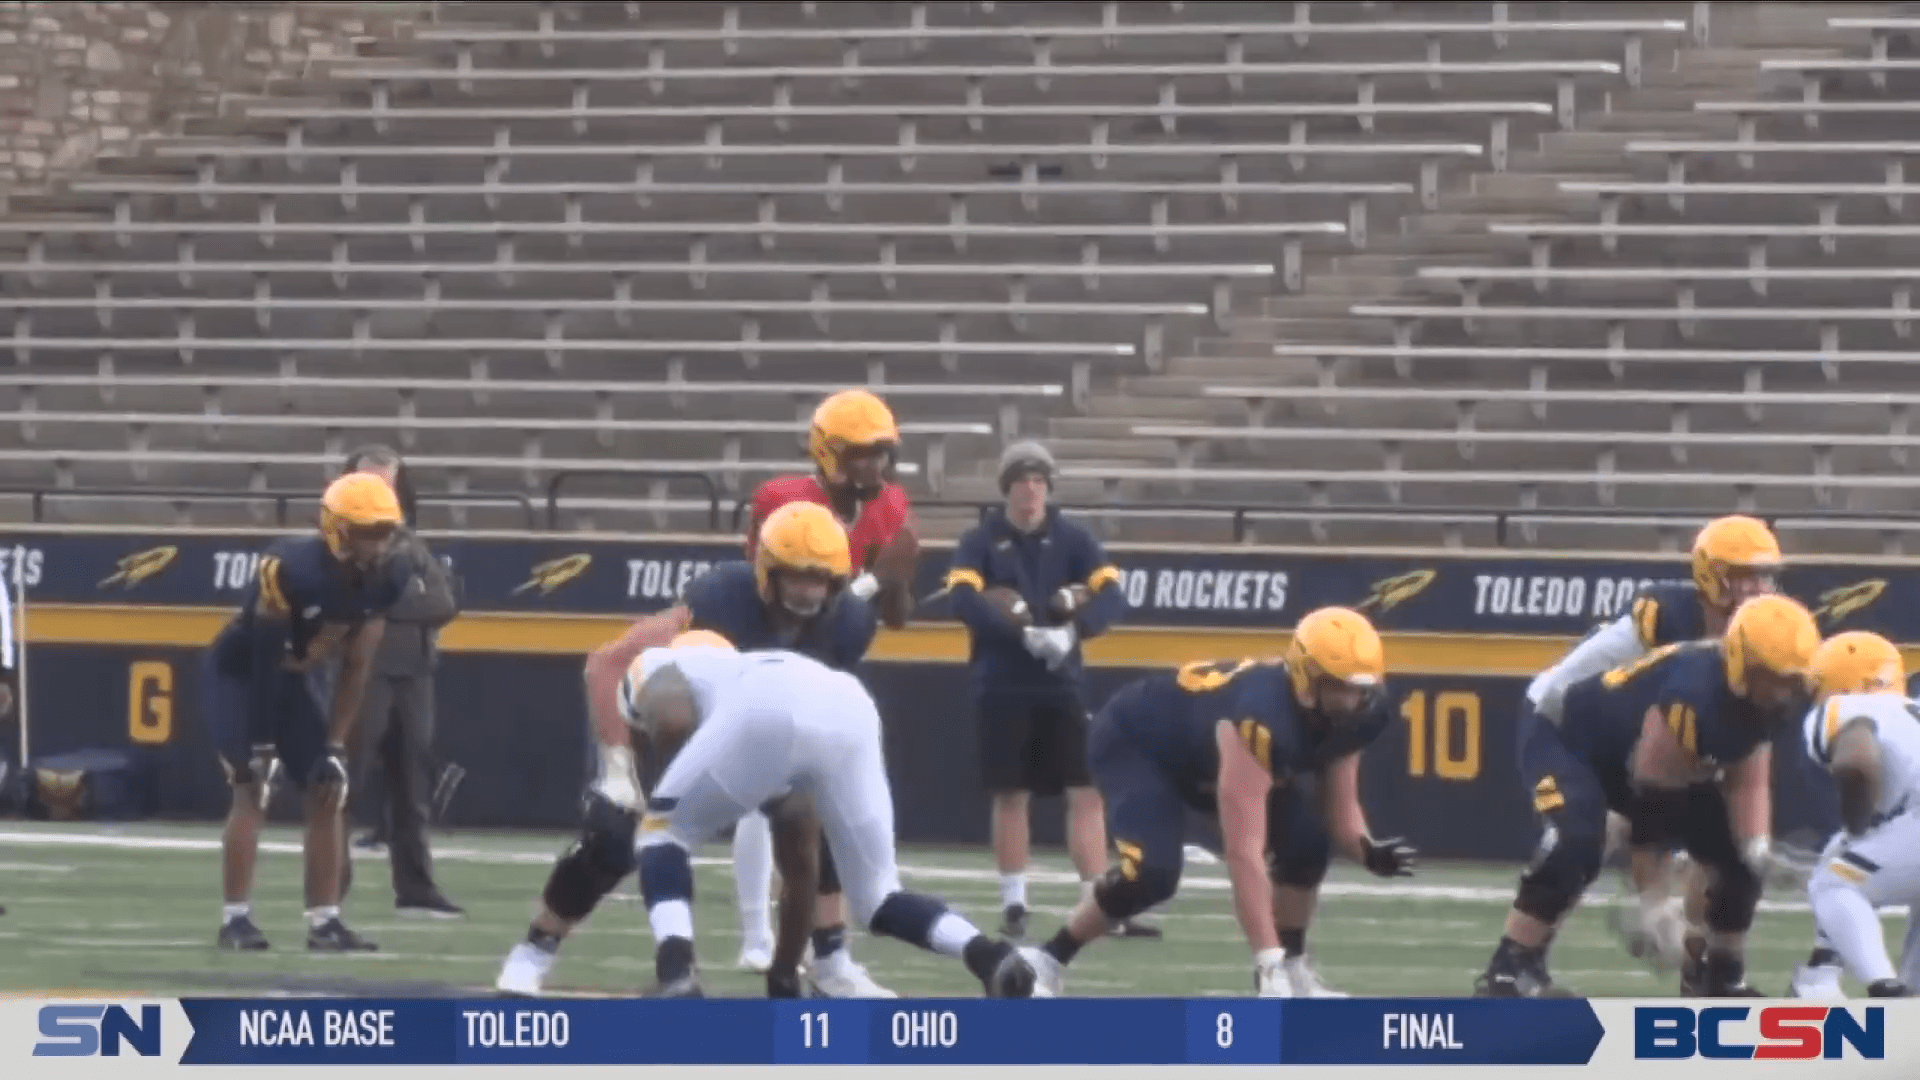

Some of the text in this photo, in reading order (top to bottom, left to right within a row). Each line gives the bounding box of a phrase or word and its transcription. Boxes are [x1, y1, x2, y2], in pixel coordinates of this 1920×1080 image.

[1154, 569, 1288, 610] ROCKETS
[1475, 575, 1587, 616] TOLEDO
[130, 660, 174, 744] G
[1401, 690, 1482, 780] 10
